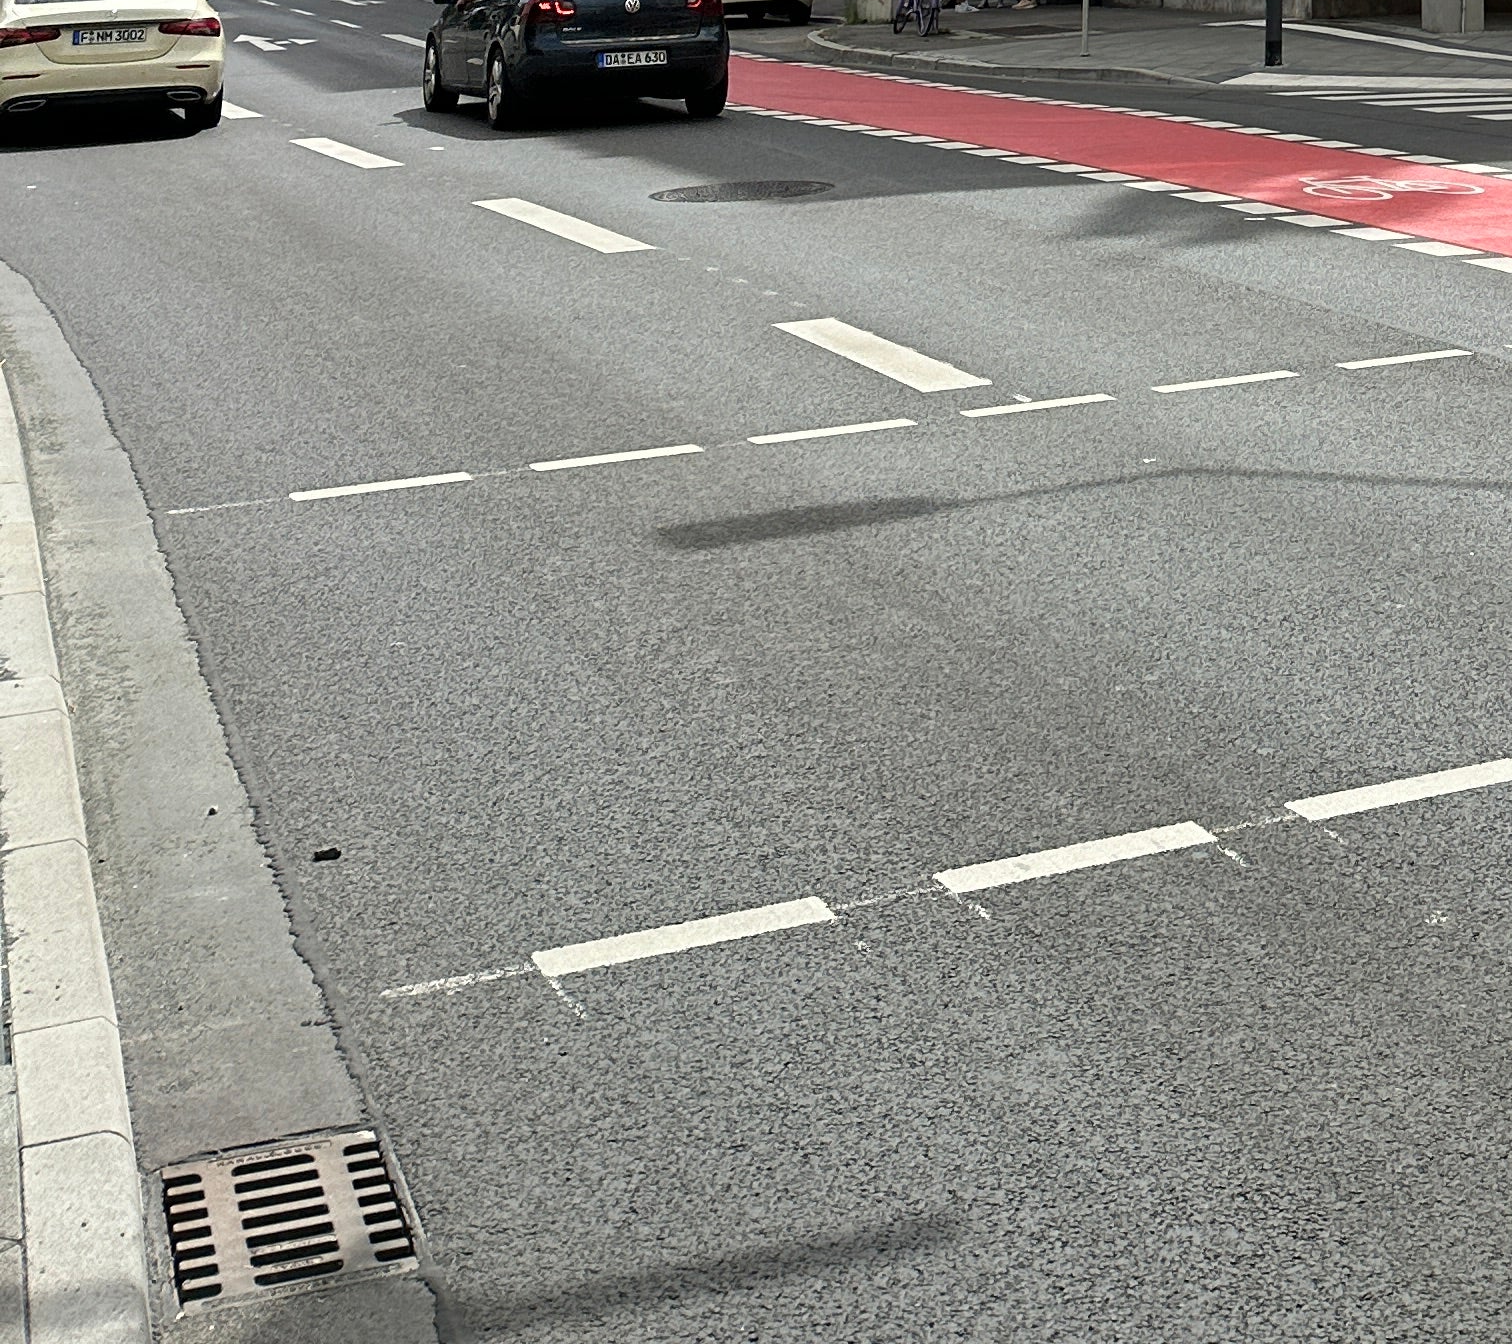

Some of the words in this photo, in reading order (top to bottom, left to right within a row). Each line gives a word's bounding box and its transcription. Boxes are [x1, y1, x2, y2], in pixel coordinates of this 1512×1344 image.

[96, 30, 113, 42] NM
[114, 29, 145, 42] 3002
[605, 53, 620, 66] DA
[627, 52, 642, 64] EA
[645, 51, 666, 64] 630
